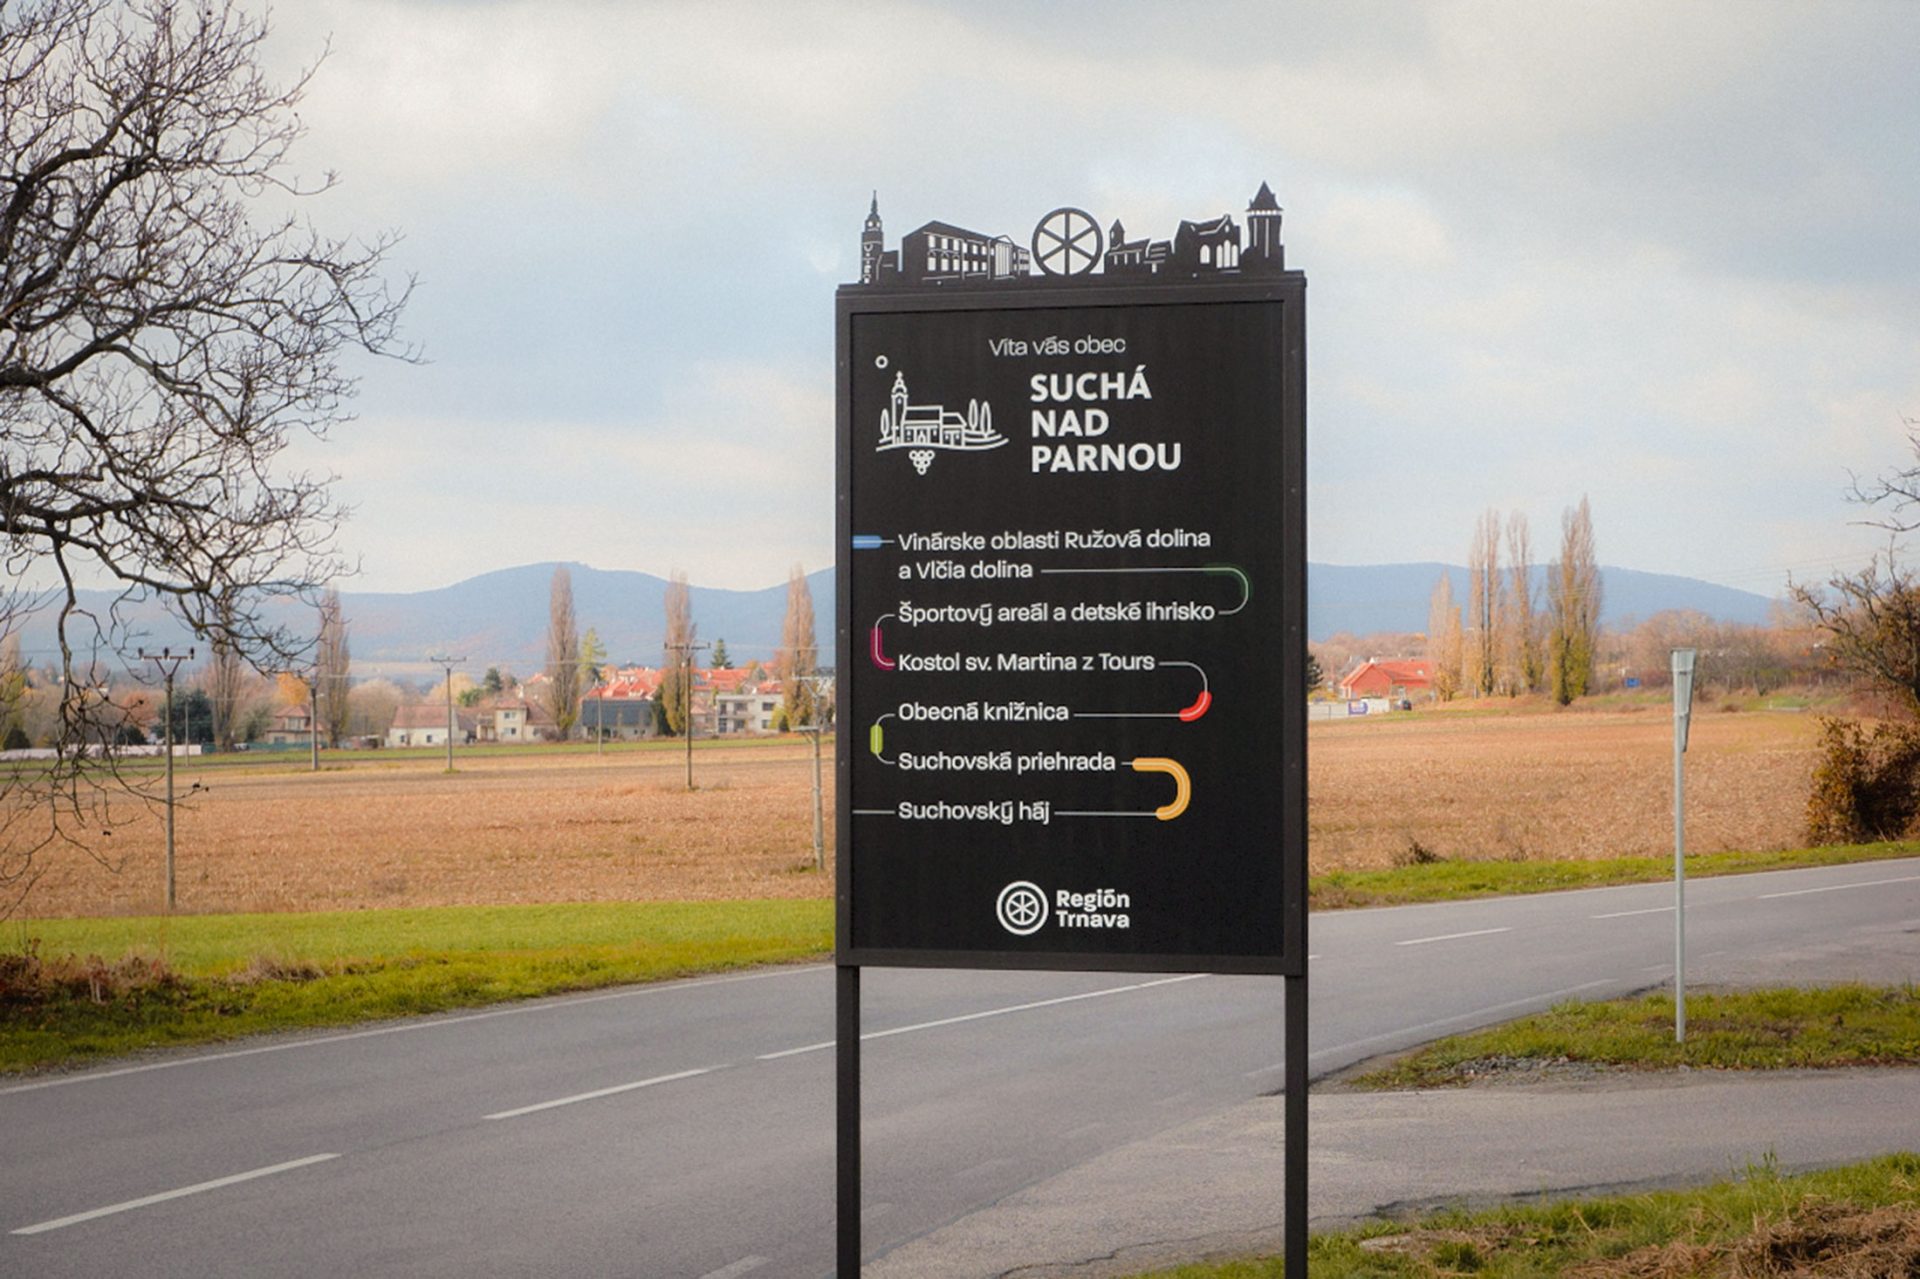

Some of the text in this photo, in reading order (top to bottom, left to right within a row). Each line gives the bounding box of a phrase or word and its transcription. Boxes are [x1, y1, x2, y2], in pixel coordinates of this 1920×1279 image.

[989, 335, 1125, 356] Víta vás obec
[1030, 365, 1152, 402] SUCHÁ
[1032, 409, 1109, 437] NAD
[1032, 443, 1181, 472] PARNOU
[898, 529, 1210, 550] Vinárske oblasti Ružová dolina
[899, 560, 1033, 579] a Vlčia dolina
[899, 601, 1215, 627] Športový areál a detské ihrisko
[899, 652, 1155, 671] Kostol sv. Martina z Tours
[899, 702, 1069, 721] Obecná knižnica
[899, 751, 1115, 775] Suchovská priehrada
[899, 801, 1049, 825] Suchovský háj
[1056, 889, 1130, 911] Región
[1056, 909, 1129, 928] Trnava
